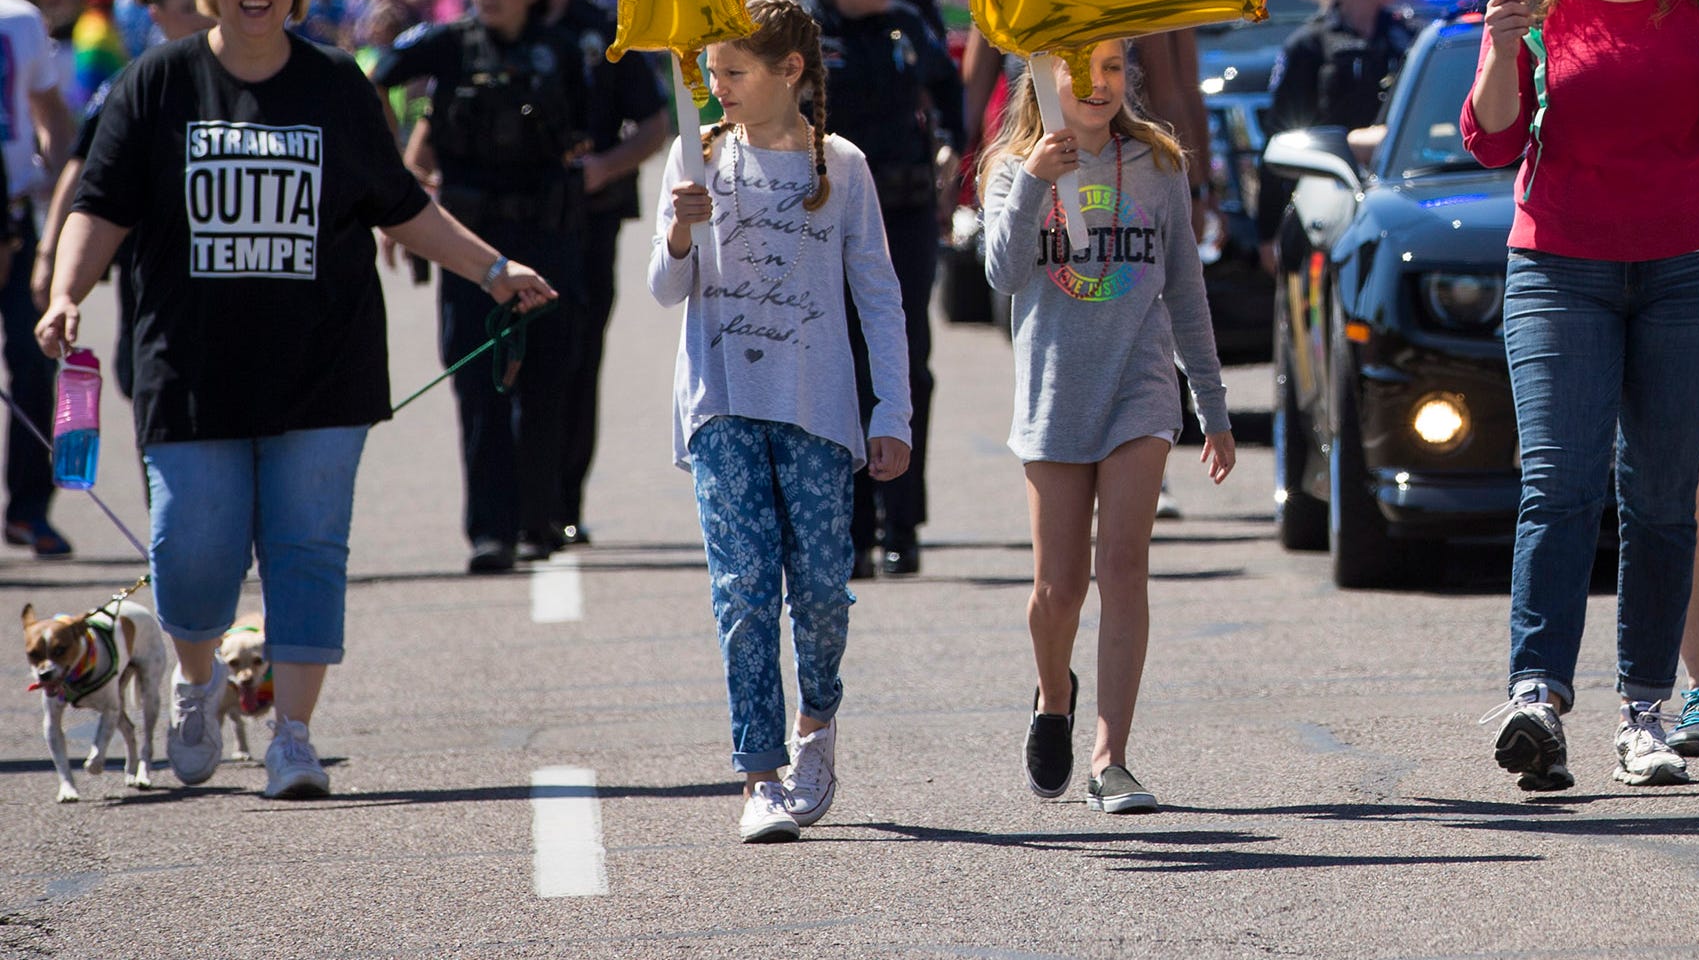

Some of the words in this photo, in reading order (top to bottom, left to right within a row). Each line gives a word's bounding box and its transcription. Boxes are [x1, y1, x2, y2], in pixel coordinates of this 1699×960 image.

[191, 127, 319, 161] STRAIGHT
[190, 167, 315, 227] OUTTA
[712, 163, 818, 212] Courag
[193, 236, 313, 271] TEMPE
[740, 242, 786, 266] in
[703, 277, 825, 324] unlikely
